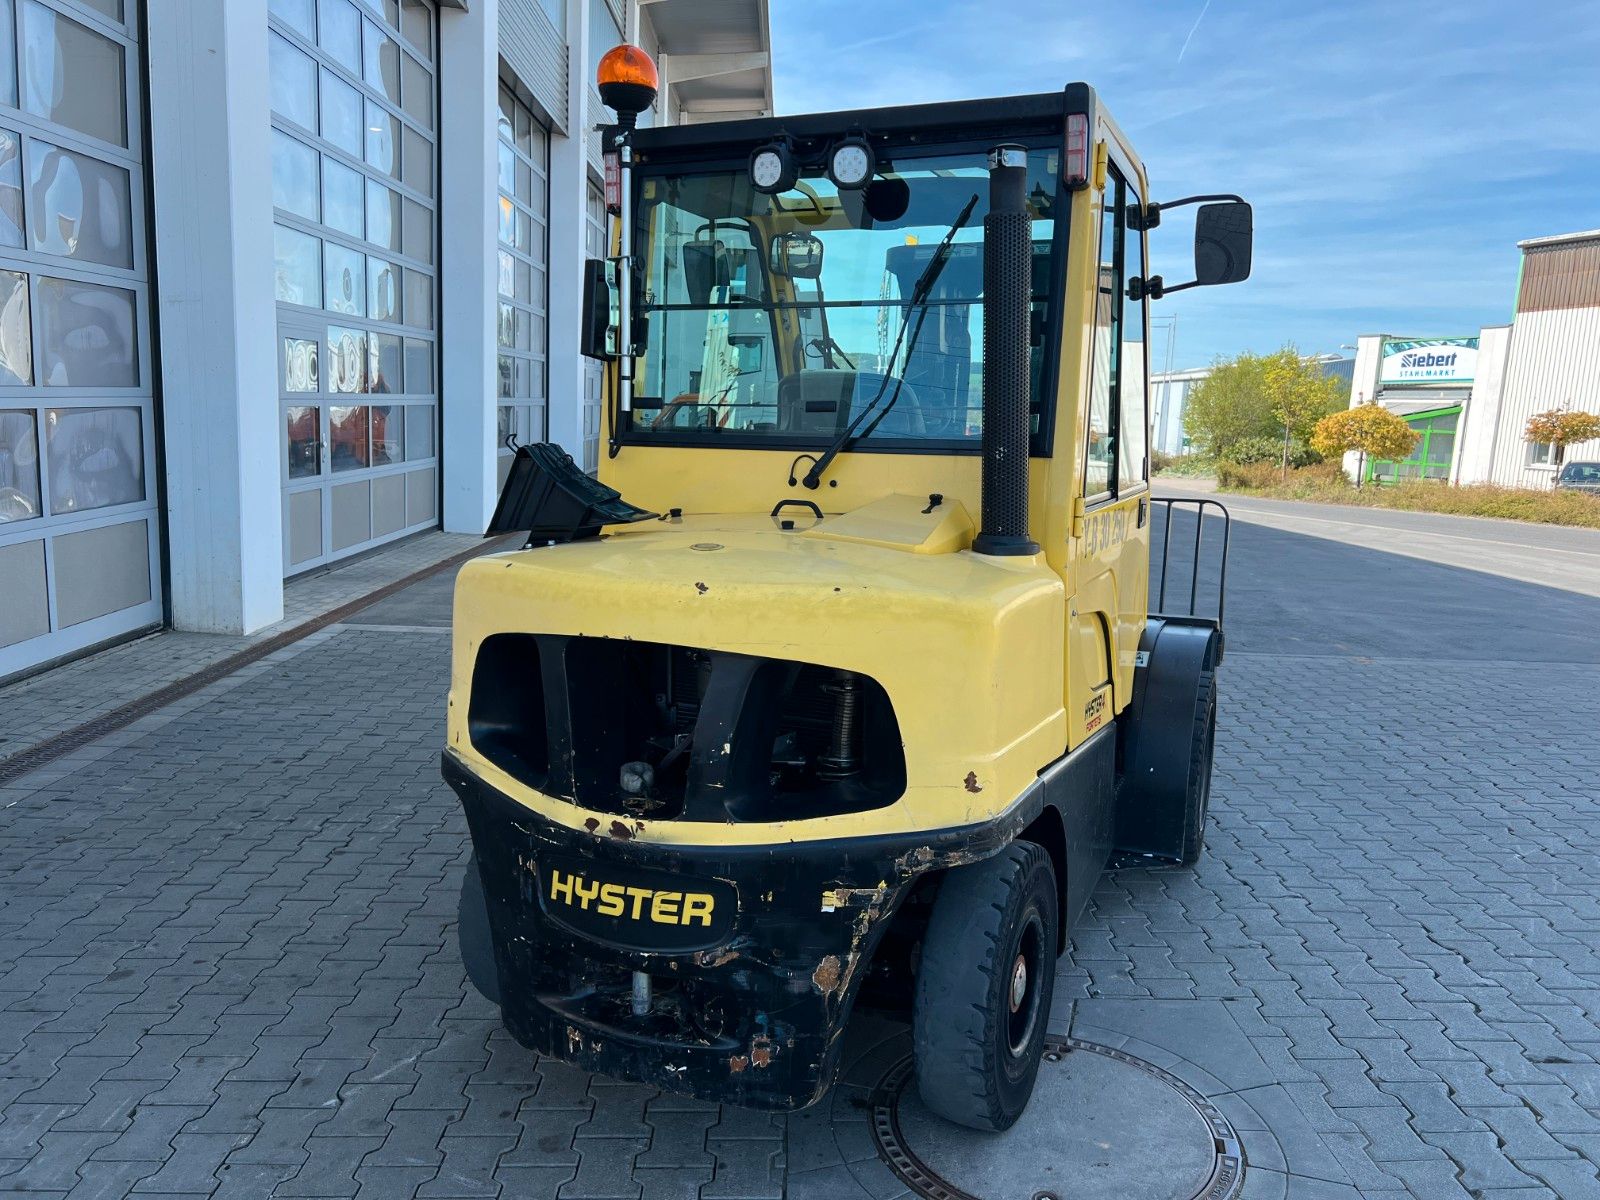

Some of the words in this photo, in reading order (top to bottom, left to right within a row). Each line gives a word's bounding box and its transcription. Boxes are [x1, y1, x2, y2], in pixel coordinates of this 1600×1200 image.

[1401, 352, 1457, 368] Siebert
[1400, 369, 1455, 377] STAHLMARKT
[550, 869, 715, 927] HYSTER
